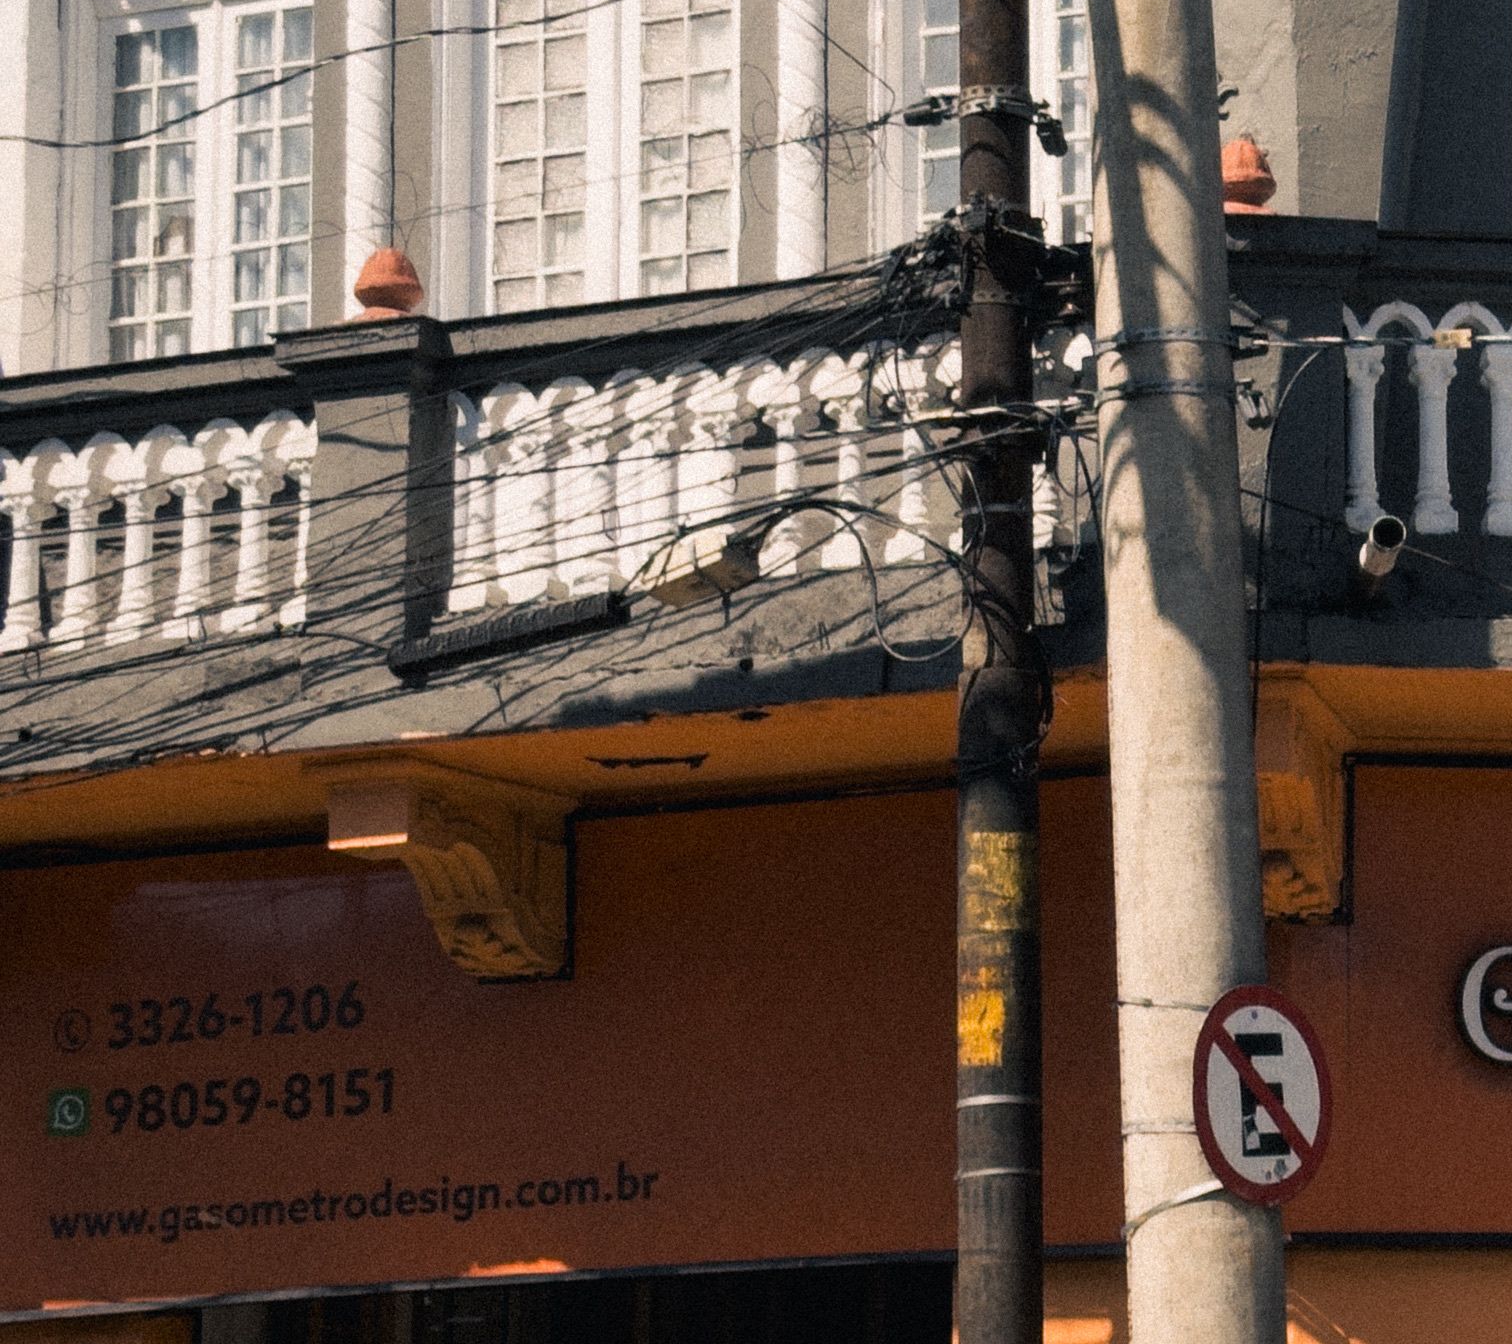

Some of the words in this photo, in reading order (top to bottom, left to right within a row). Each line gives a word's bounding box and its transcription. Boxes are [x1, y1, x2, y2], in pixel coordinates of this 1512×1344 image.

[108, 980, 366, 1049] 3326-1206
[105, 1068, 397, 1133] 98059-8151
[49, 1163, 659, 1242] www.gasometrodesign.com.br
